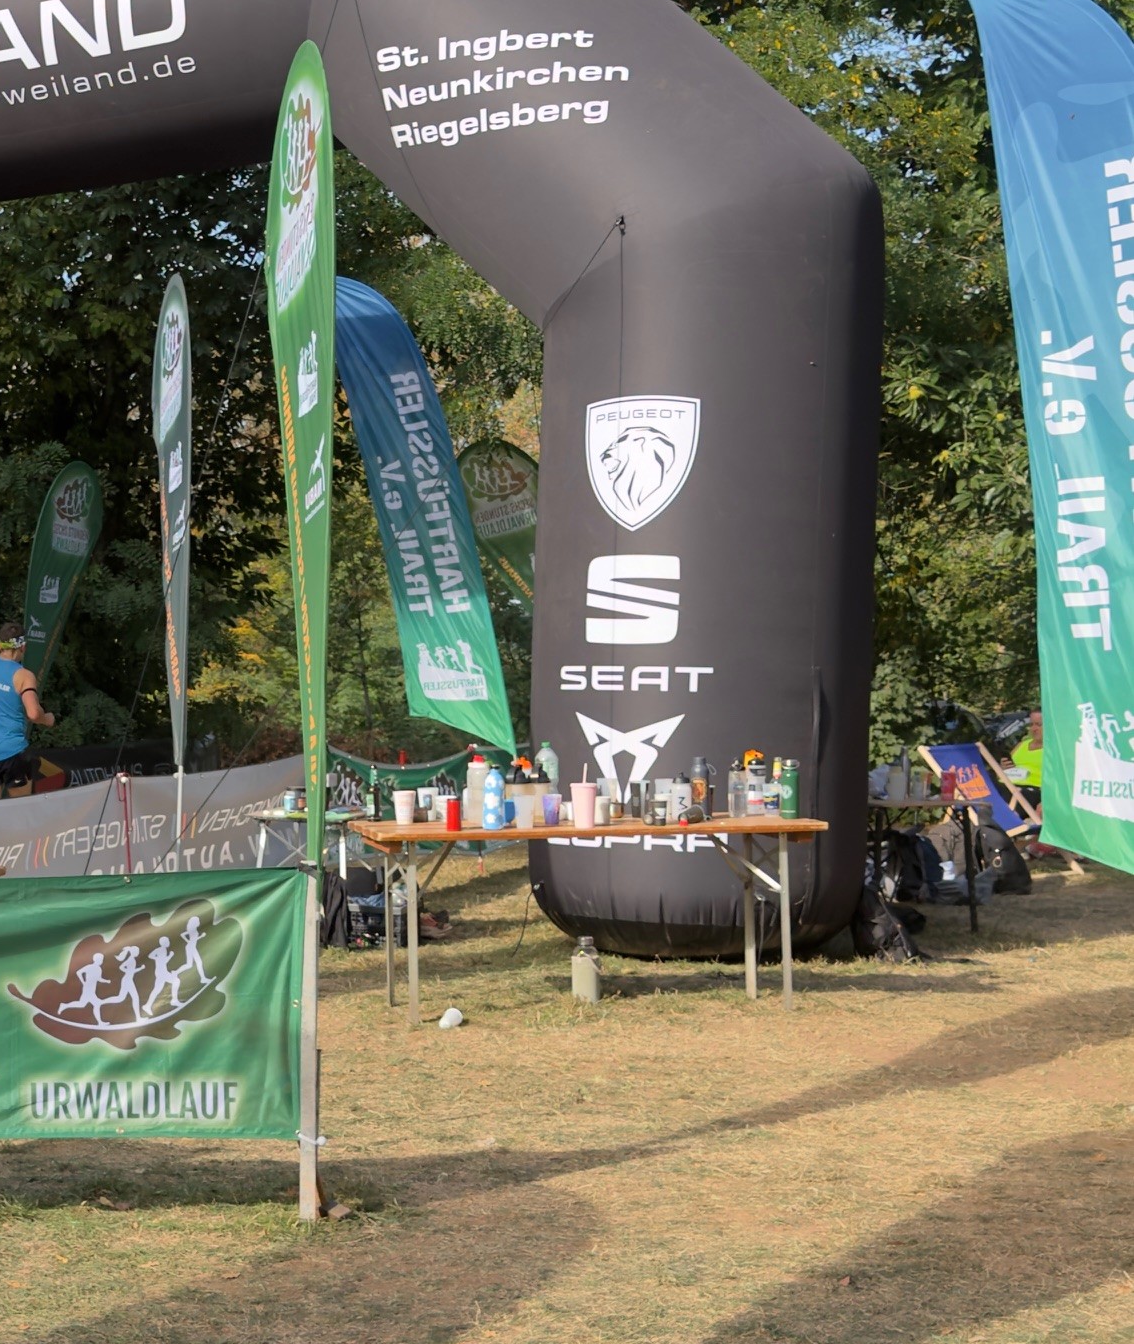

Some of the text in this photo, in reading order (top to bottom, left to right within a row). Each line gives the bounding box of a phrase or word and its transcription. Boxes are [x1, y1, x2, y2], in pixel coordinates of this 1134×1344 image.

[376, 29, 595, 73] St. Ingbert
[382, 61, 630, 112] Neunkirchen
[390, 99, 610, 149] Riegelsberg
[596, 408, 687, 423] PEUGEOT
[560, 665, 715, 693] SEAT
[30, 1080, 239, 1120] URWALDLAUF
